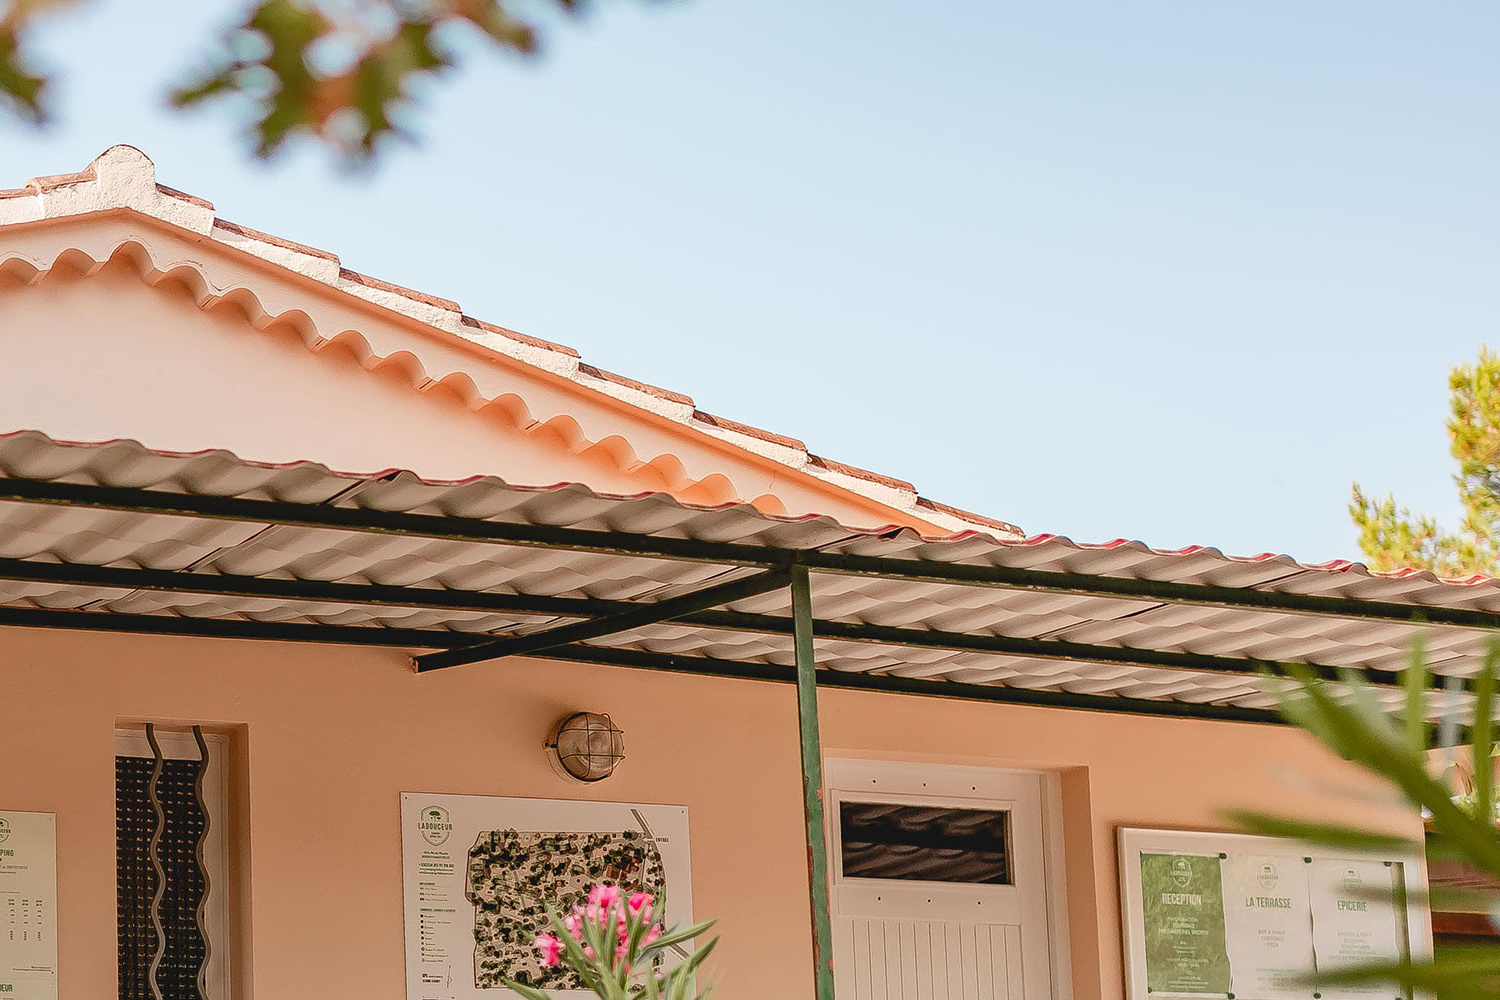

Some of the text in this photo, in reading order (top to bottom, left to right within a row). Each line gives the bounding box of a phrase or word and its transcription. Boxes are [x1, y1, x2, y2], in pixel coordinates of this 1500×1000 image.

[418, 822, 452, 830] LADOUCEUR
[1162, 892, 1202, 905] RECEPTION
[1246, 897, 1292, 908] LA TERRASSE
[1337, 900, 1368, 912] EPICERIE
